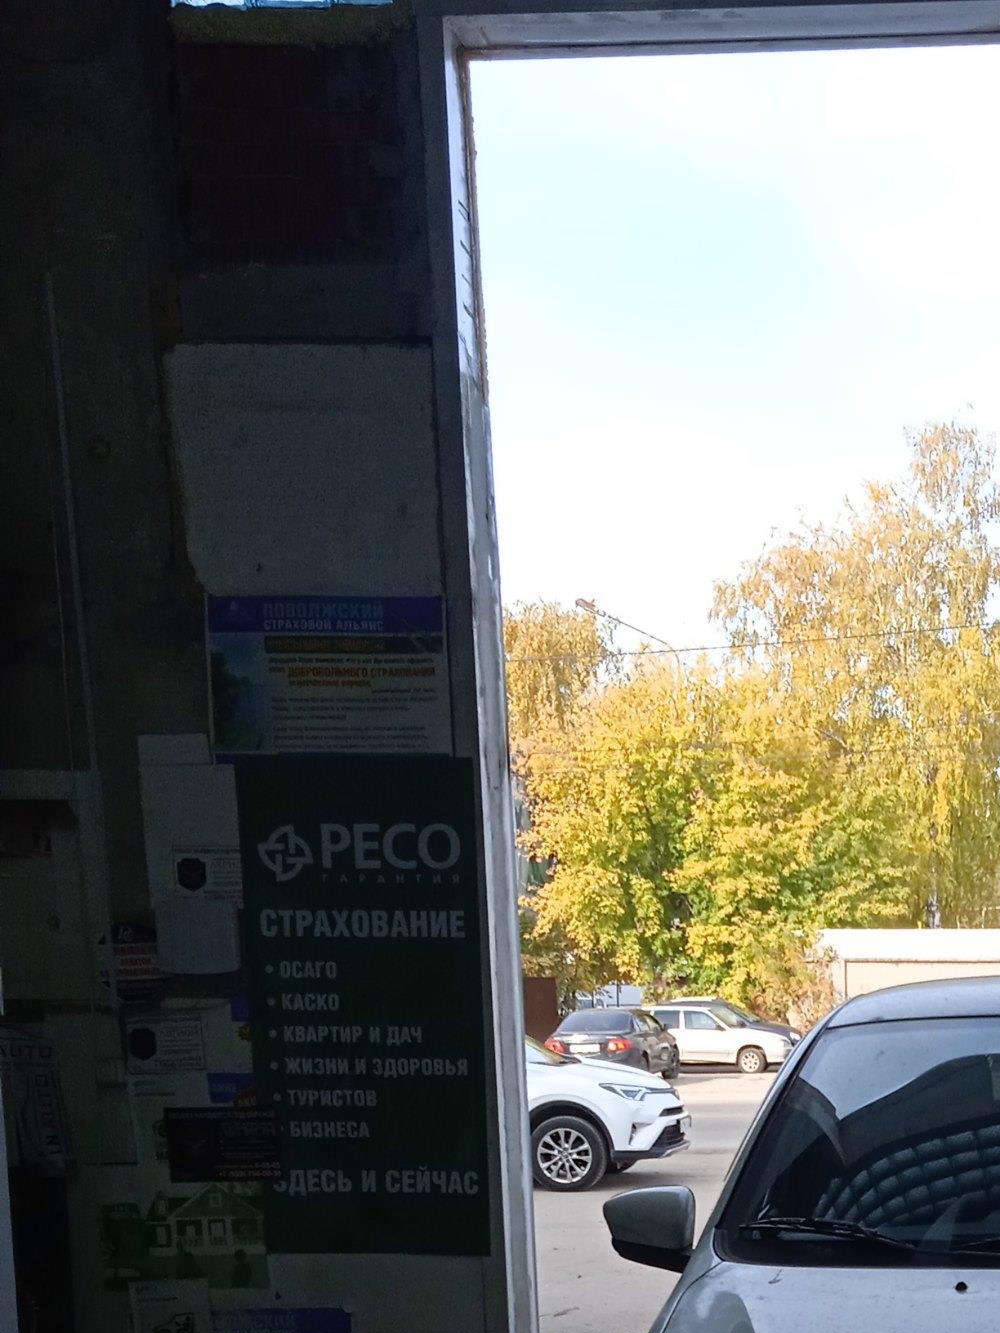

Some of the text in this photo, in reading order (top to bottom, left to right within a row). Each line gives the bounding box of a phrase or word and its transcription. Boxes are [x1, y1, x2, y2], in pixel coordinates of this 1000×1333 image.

[263, 600, 384, 619] ПОВОЛЖСКИЙ
[263, 619, 384, 632] СТРАХОВОЙ АЛЬЯНС
[320, 823, 461, 869] РЕСО
[322, 873, 461, 884] ГАРАНТИЯ
[260, 909, 466, 938] СТРАХОВАНИЕ
[280, 960, 338, 979] ОСАГО
[282, 993, 340, 1011] КАСКО
[283, 1025, 423, 1046] КВАРТИР И ДАЧ
[285, 1058, 468, 1078] ЖИЗНИ И ЗДОРОВЬЯ
[286, 1090, 377, 1107] ТУРИСТОВ
[289, 1120, 370, 1138] БИЗНЕСА
[361, 1169, 377, 1193] И
[385, 1166, 480, 1194] СЕЙЧАС
